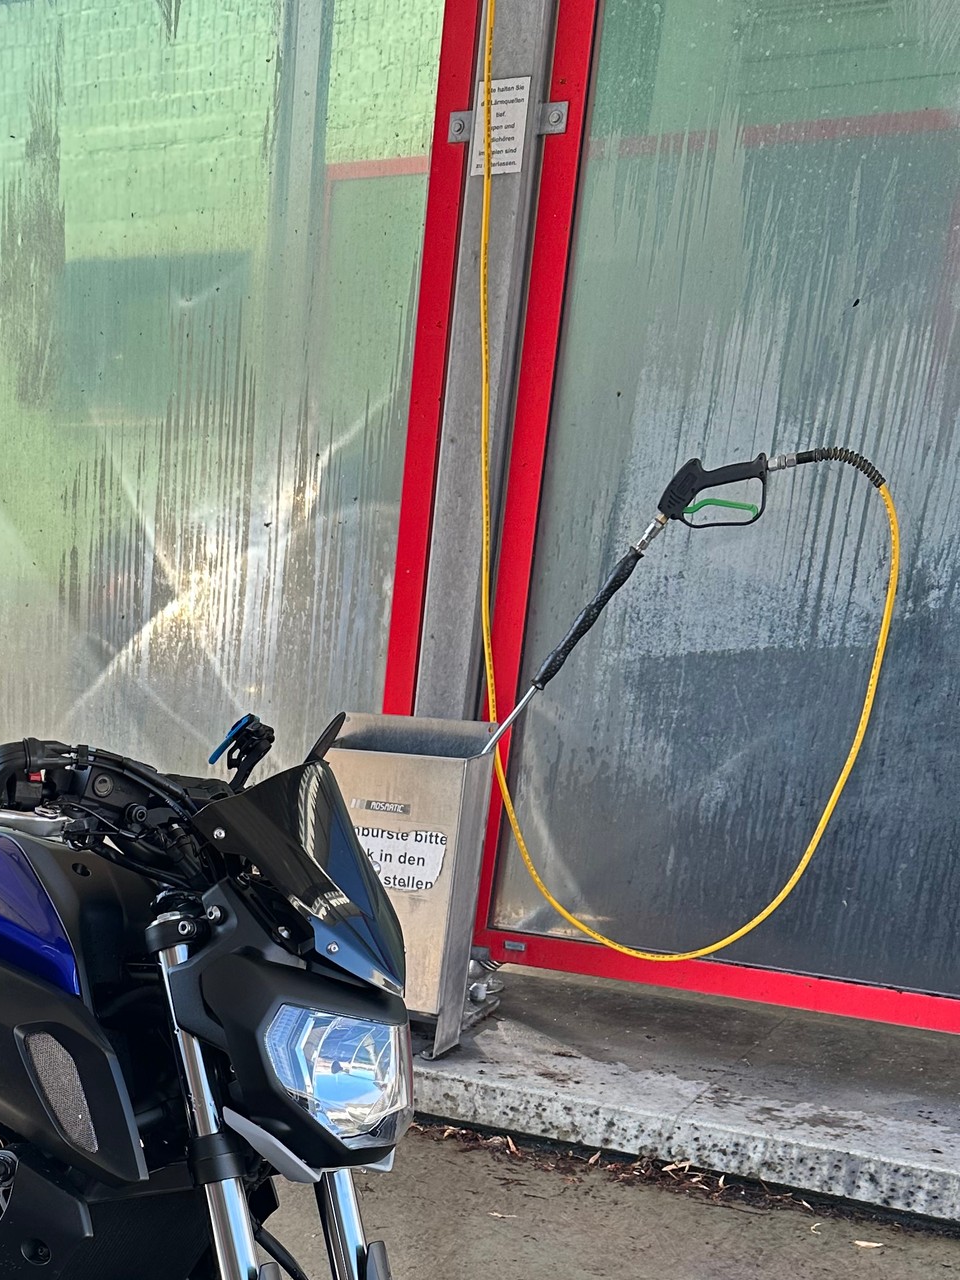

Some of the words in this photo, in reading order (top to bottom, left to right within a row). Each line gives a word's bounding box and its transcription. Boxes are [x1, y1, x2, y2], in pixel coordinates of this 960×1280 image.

[415, 831, 447, 845] bitte
[380, 850, 392, 862] in
[398, 852, 425, 866] den
